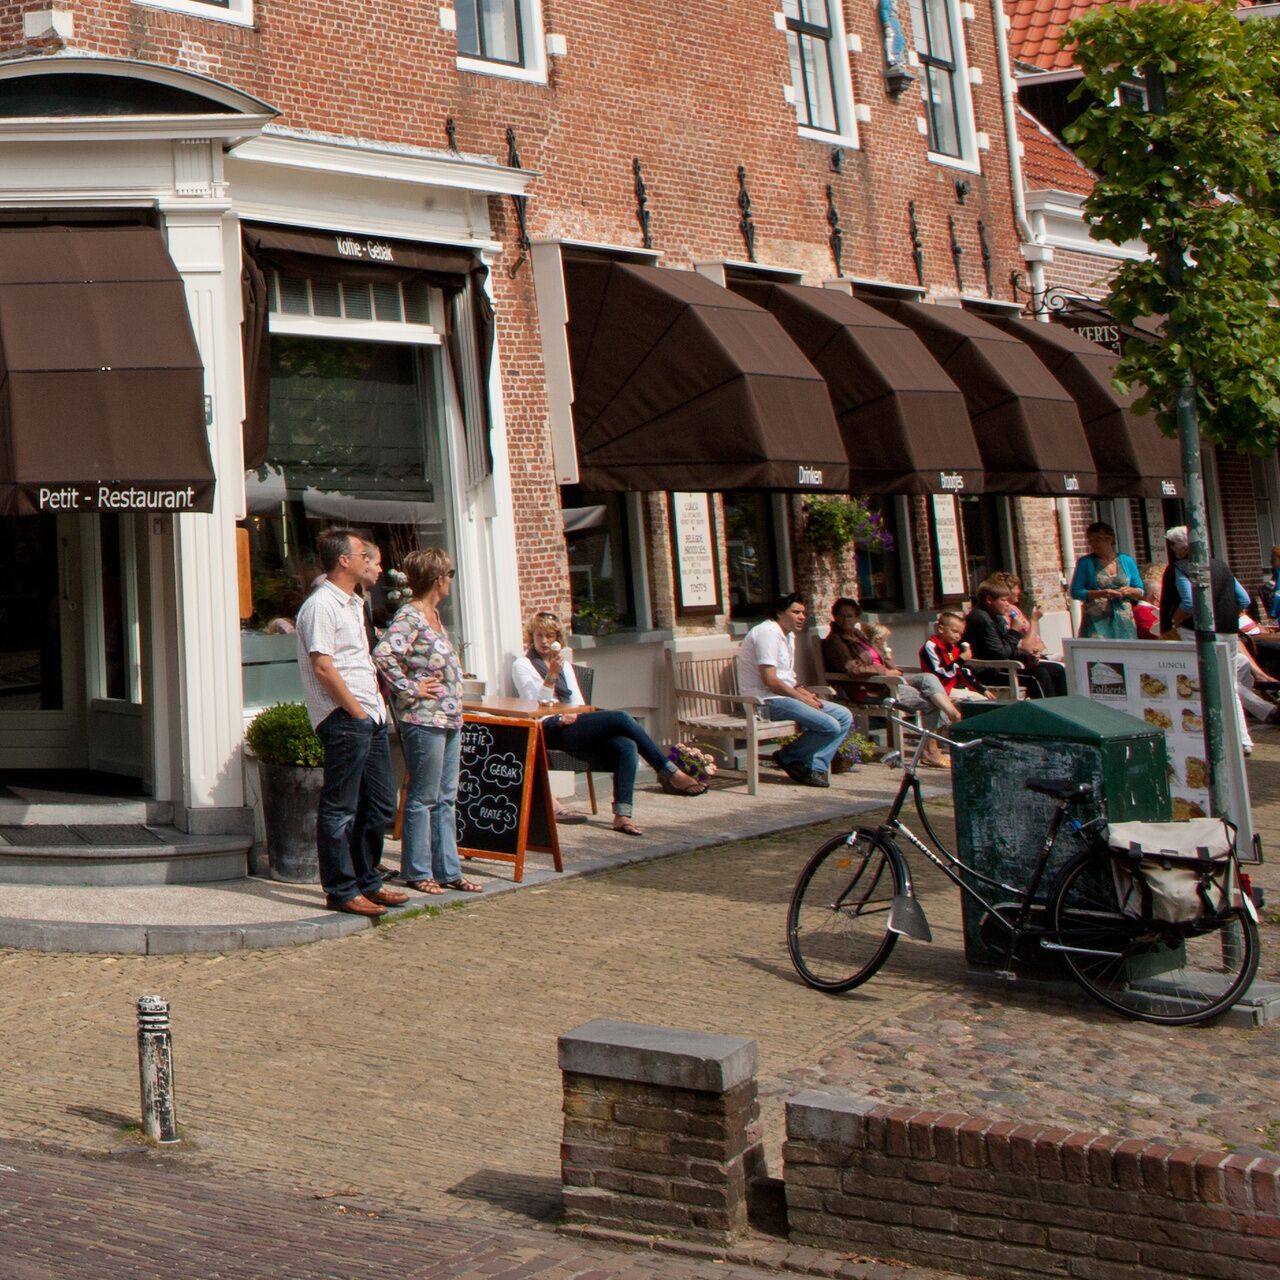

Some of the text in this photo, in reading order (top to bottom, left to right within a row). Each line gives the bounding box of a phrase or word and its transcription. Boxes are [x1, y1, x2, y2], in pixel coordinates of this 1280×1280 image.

[336, 236, 362, 257] Koffie
[367, 240, 394, 261] Gebak
[799, 465, 823, 484] Drinken
[39, 488, 79, 509] Petit
[98, 487, 195, 508] Restaurant
[1158, 661, 1186, 669] LUNCH
[489, 763, 517, 778] GEBAK
